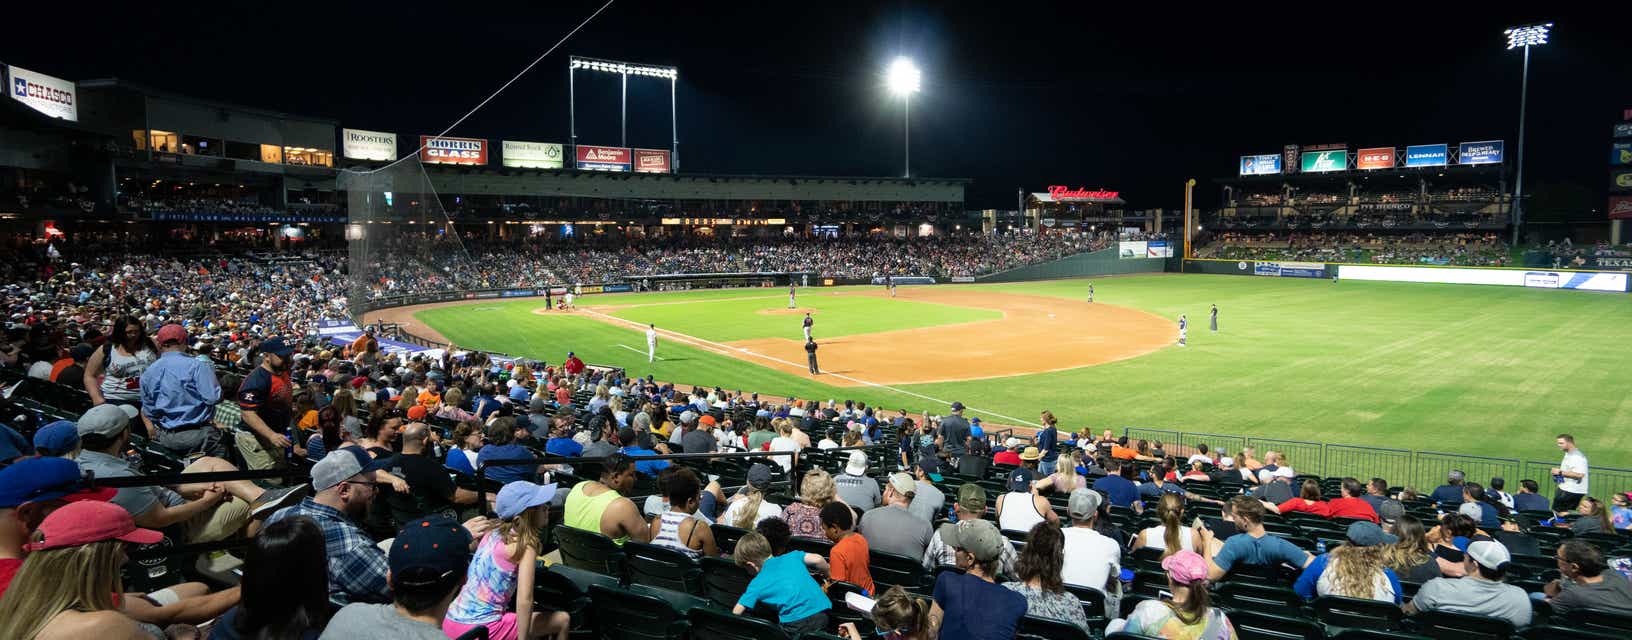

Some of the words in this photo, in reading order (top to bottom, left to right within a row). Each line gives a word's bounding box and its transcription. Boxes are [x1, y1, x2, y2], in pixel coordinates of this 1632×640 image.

[28, 82, 73, 105] CHASCO
[350, 132, 394, 145] ROOSTERS
[427, 139, 482, 150] MORRIS
[427, 149, 480, 159] GLASS
[1048, 185, 1119, 199] Budweiser
